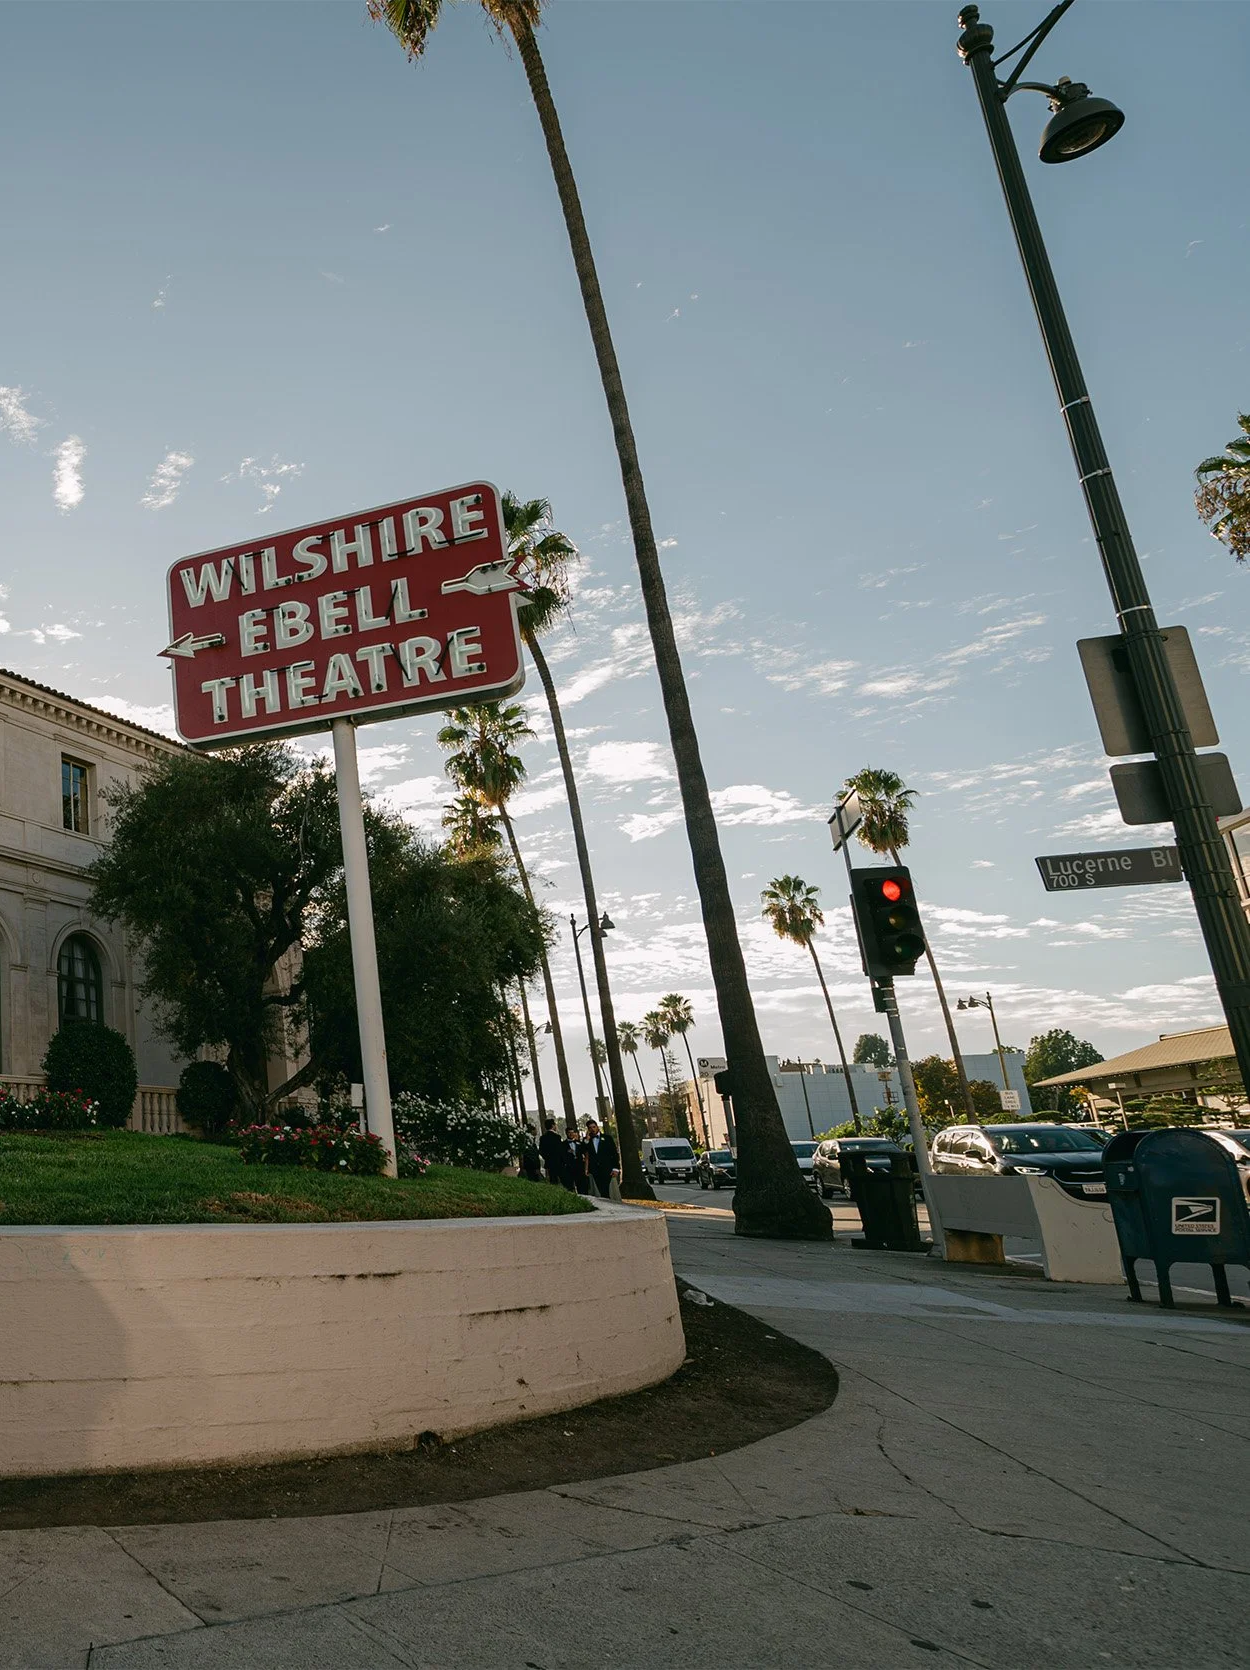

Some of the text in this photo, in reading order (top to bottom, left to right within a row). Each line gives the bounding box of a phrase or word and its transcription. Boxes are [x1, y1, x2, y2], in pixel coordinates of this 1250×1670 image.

[180, 494, 488, 608] WILSHIRE
[239, 577, 428, 657] EBELL
[201, 626, 487, 724] THEATRE
[1046, 850, 1174, 876] Lucerne Bl
[1050, 872, 1096, 888] 700 S
